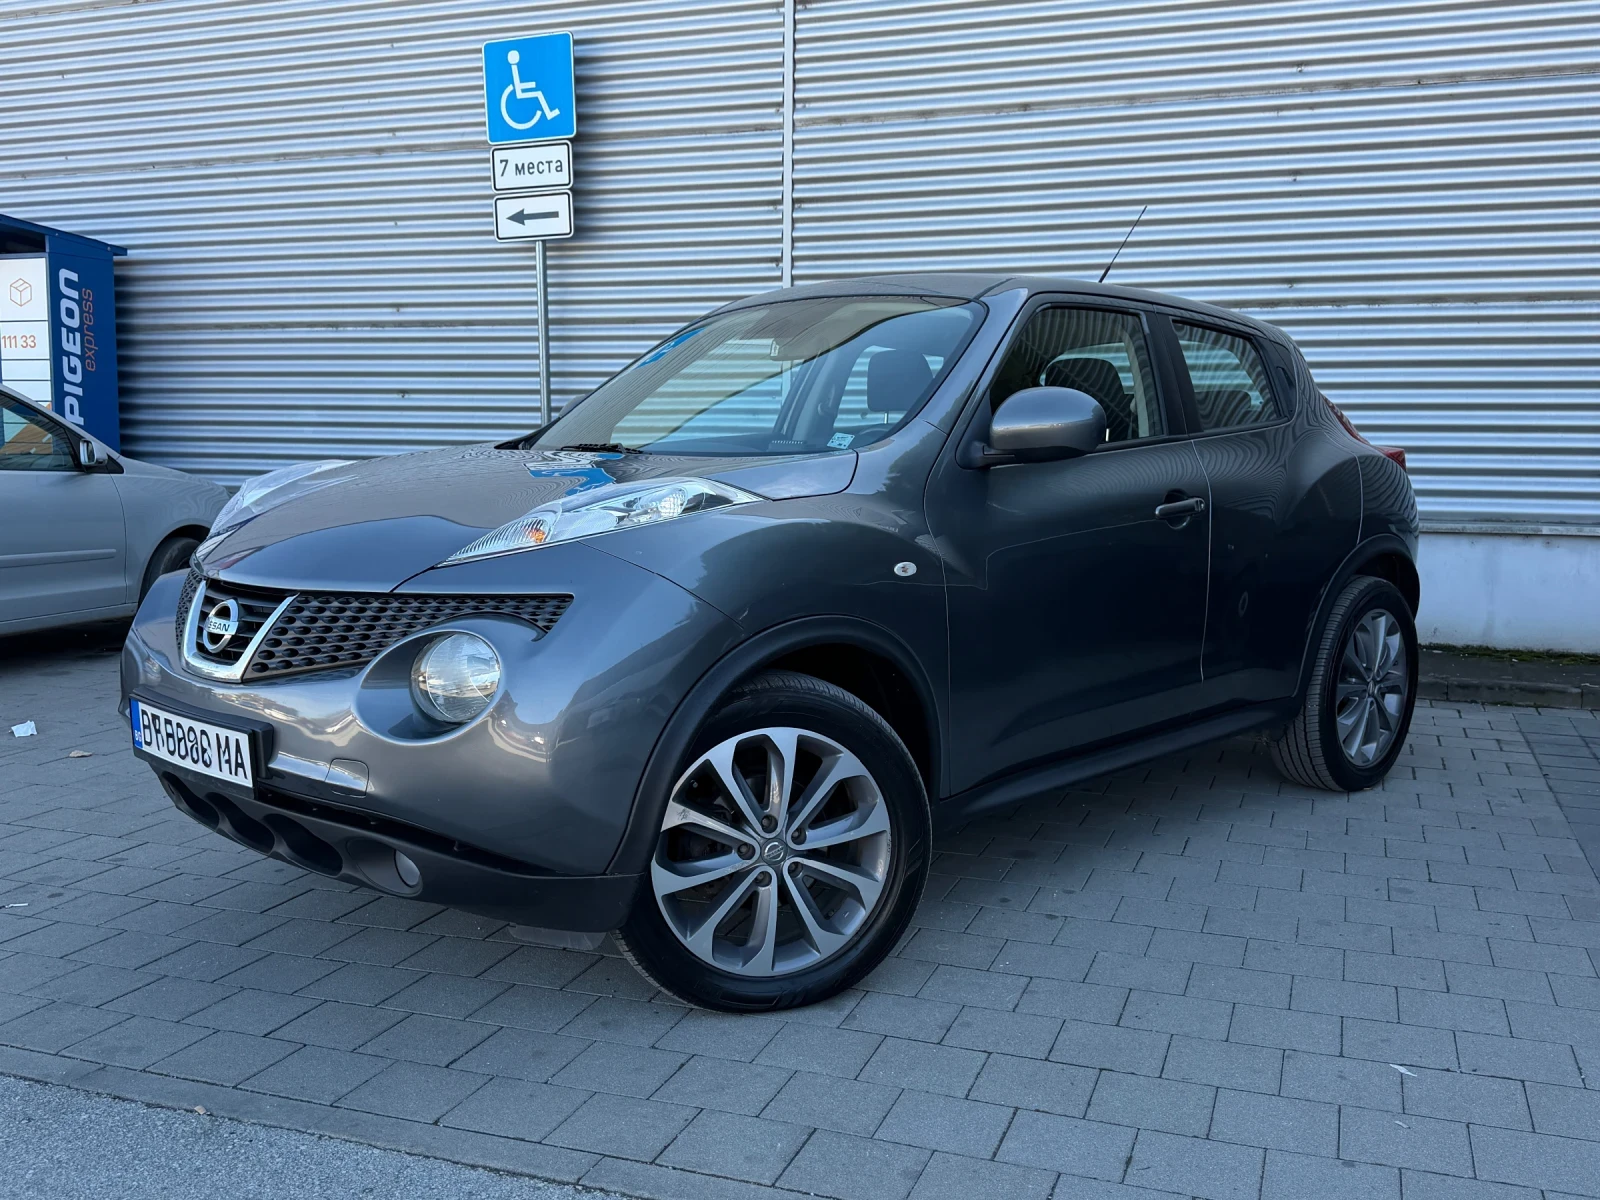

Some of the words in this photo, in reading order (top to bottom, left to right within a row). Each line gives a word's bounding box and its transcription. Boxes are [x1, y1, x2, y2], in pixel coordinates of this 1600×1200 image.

[499, 159, 509, 177] 7
[515, 159, 563, 176] места
[1, 335, 18, 349] 111
[20, 334, 37, 349] 33
[58, 268, 85, 426] PIGEON
[82, 288, 99, 372] express
